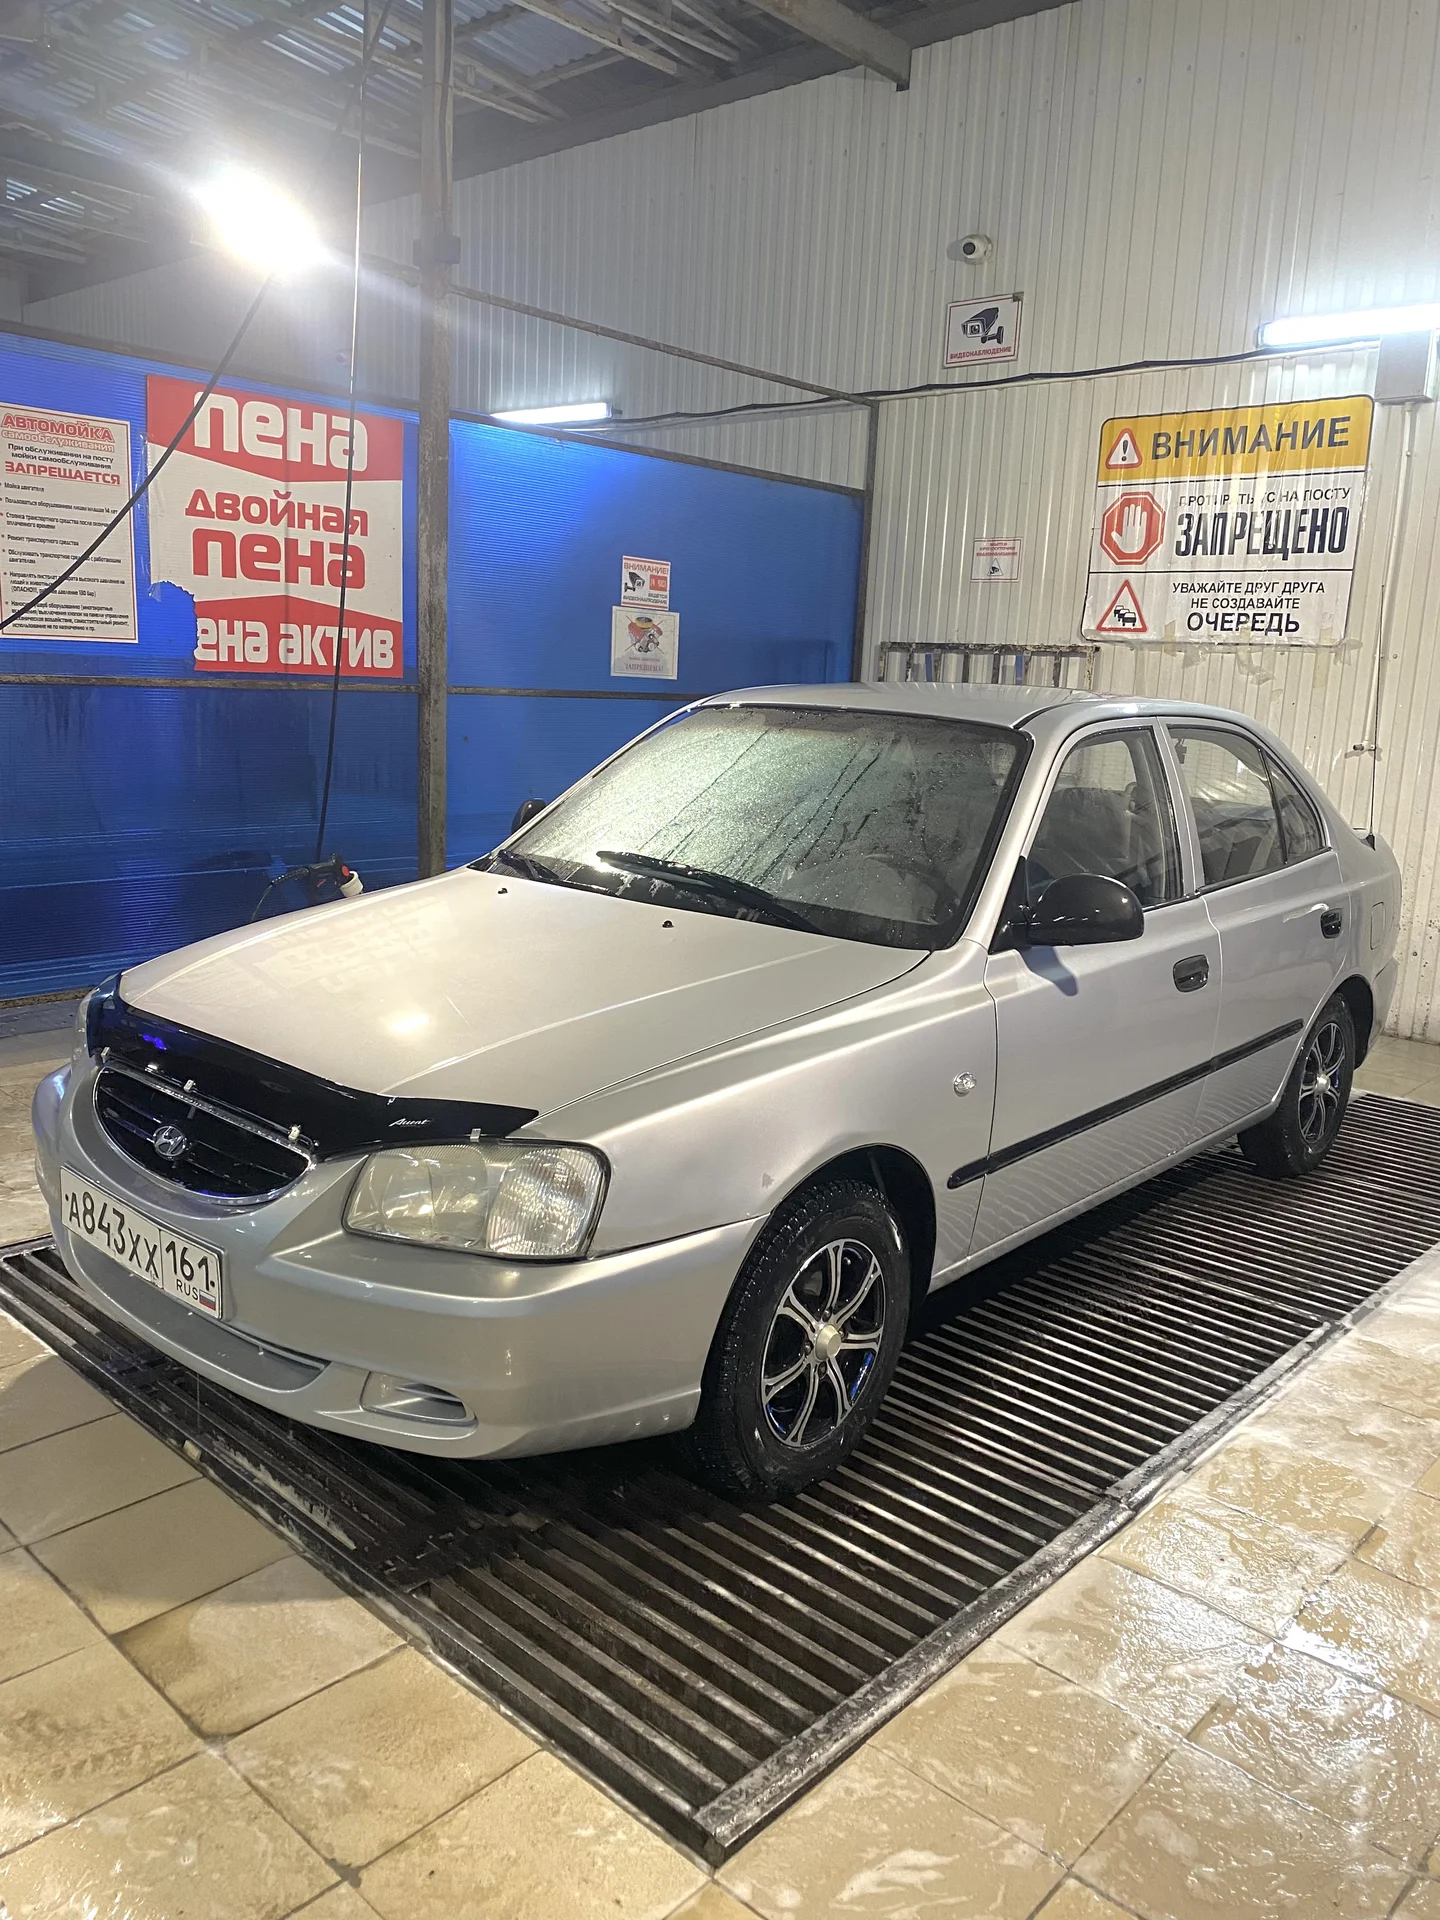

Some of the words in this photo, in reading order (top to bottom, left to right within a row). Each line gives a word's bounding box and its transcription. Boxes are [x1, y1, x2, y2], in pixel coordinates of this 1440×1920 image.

[950, 346, 1012, 359] ВИДЕОНАБЛЮДЕНИЕ
[2, 413, 115, 443] АВТОМОЙКА
[1151, 416, 1351, 460] ВНИМАНИЕ
[2, 430, 115, 453] самообслуживания
[8, 443, 24, 451] При
[93, 455, 114, 464] посту
[5, 461, 120, 485] ЗАПРЕЩАЕТСЯ
[1179, 492, 1255, 507] ПРОТИРТЬ
[1280, 490, 1299, 502] НА
[1303, 487, 1351, 501] ПОСТУ
[1175, 507, 1350, 560] ЗАПРЕЩЕНО
[1173, 580, 1243, 594] УВАЖАЙТЕ
[1244, 581, 1280, 595] ДРУГ
[1281, 581, 1325, 595] ДРУГА
[1191, 597, 1209, 609] НЕ
[1212, 595, 1300, 611] СОЗДАВАЙТЕ
[1187, 611, 1300, 637] ОЧЕРЕДЬ
[193, 617, 269, 663] ена
[69, 1191, 159, 1278] А843ХХ
[165, 1240, 210, 1291] 161
[176, 1279, 199, 1301] RUS
